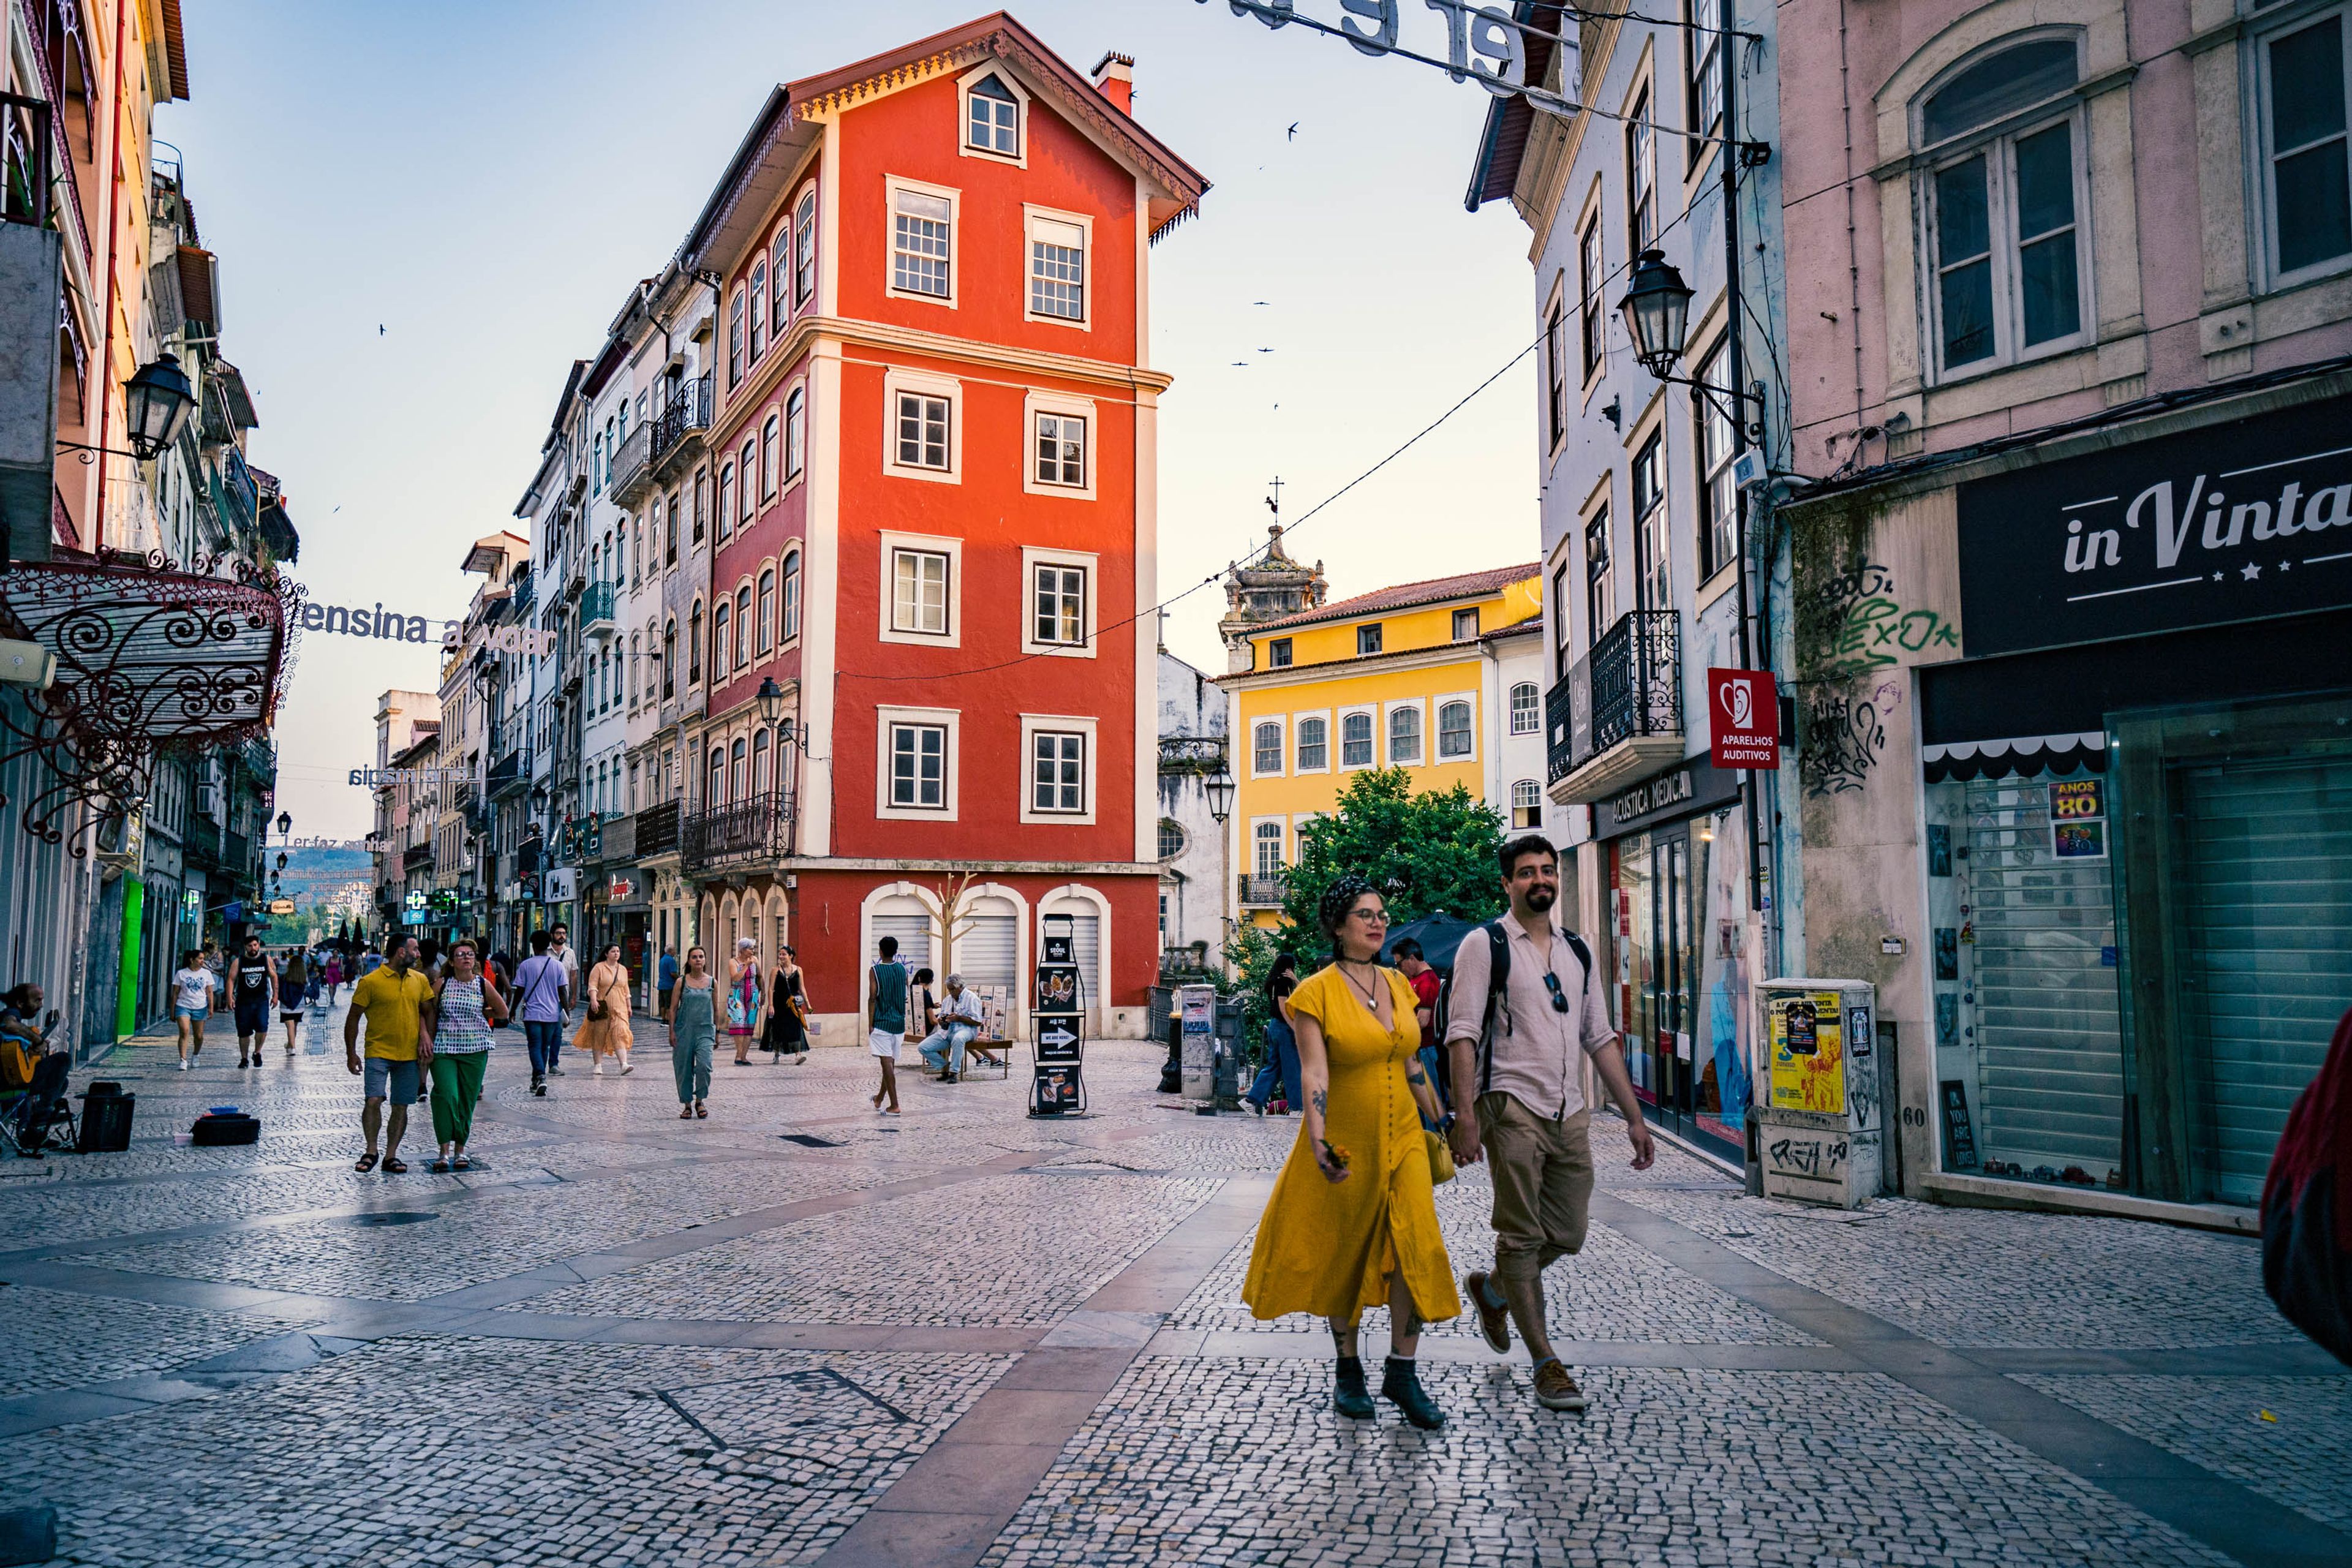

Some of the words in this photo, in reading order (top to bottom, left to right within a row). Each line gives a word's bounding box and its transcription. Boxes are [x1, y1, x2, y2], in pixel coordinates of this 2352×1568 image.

[2064, 519, 2121, 573] in
[306, 602, 428, 644] ensina
[442, 620, 464, 648] a
[483, 623, 557, 655] voar
[1722, 734, 1773, 746] APARELHOS
[1723, 750, 1771, 761] AUDITIVOS
[2059, 782, 2095, 794] ANOS
[2057, 794, 2097, 819] 80
[1903, 1106, 1924, 1127] 60
[1950, 1109, 1967, 1124] YOU
[1954, 1126, 1970, 1140] ARE
[1956, 1152, 1975, 1166] LOVED
